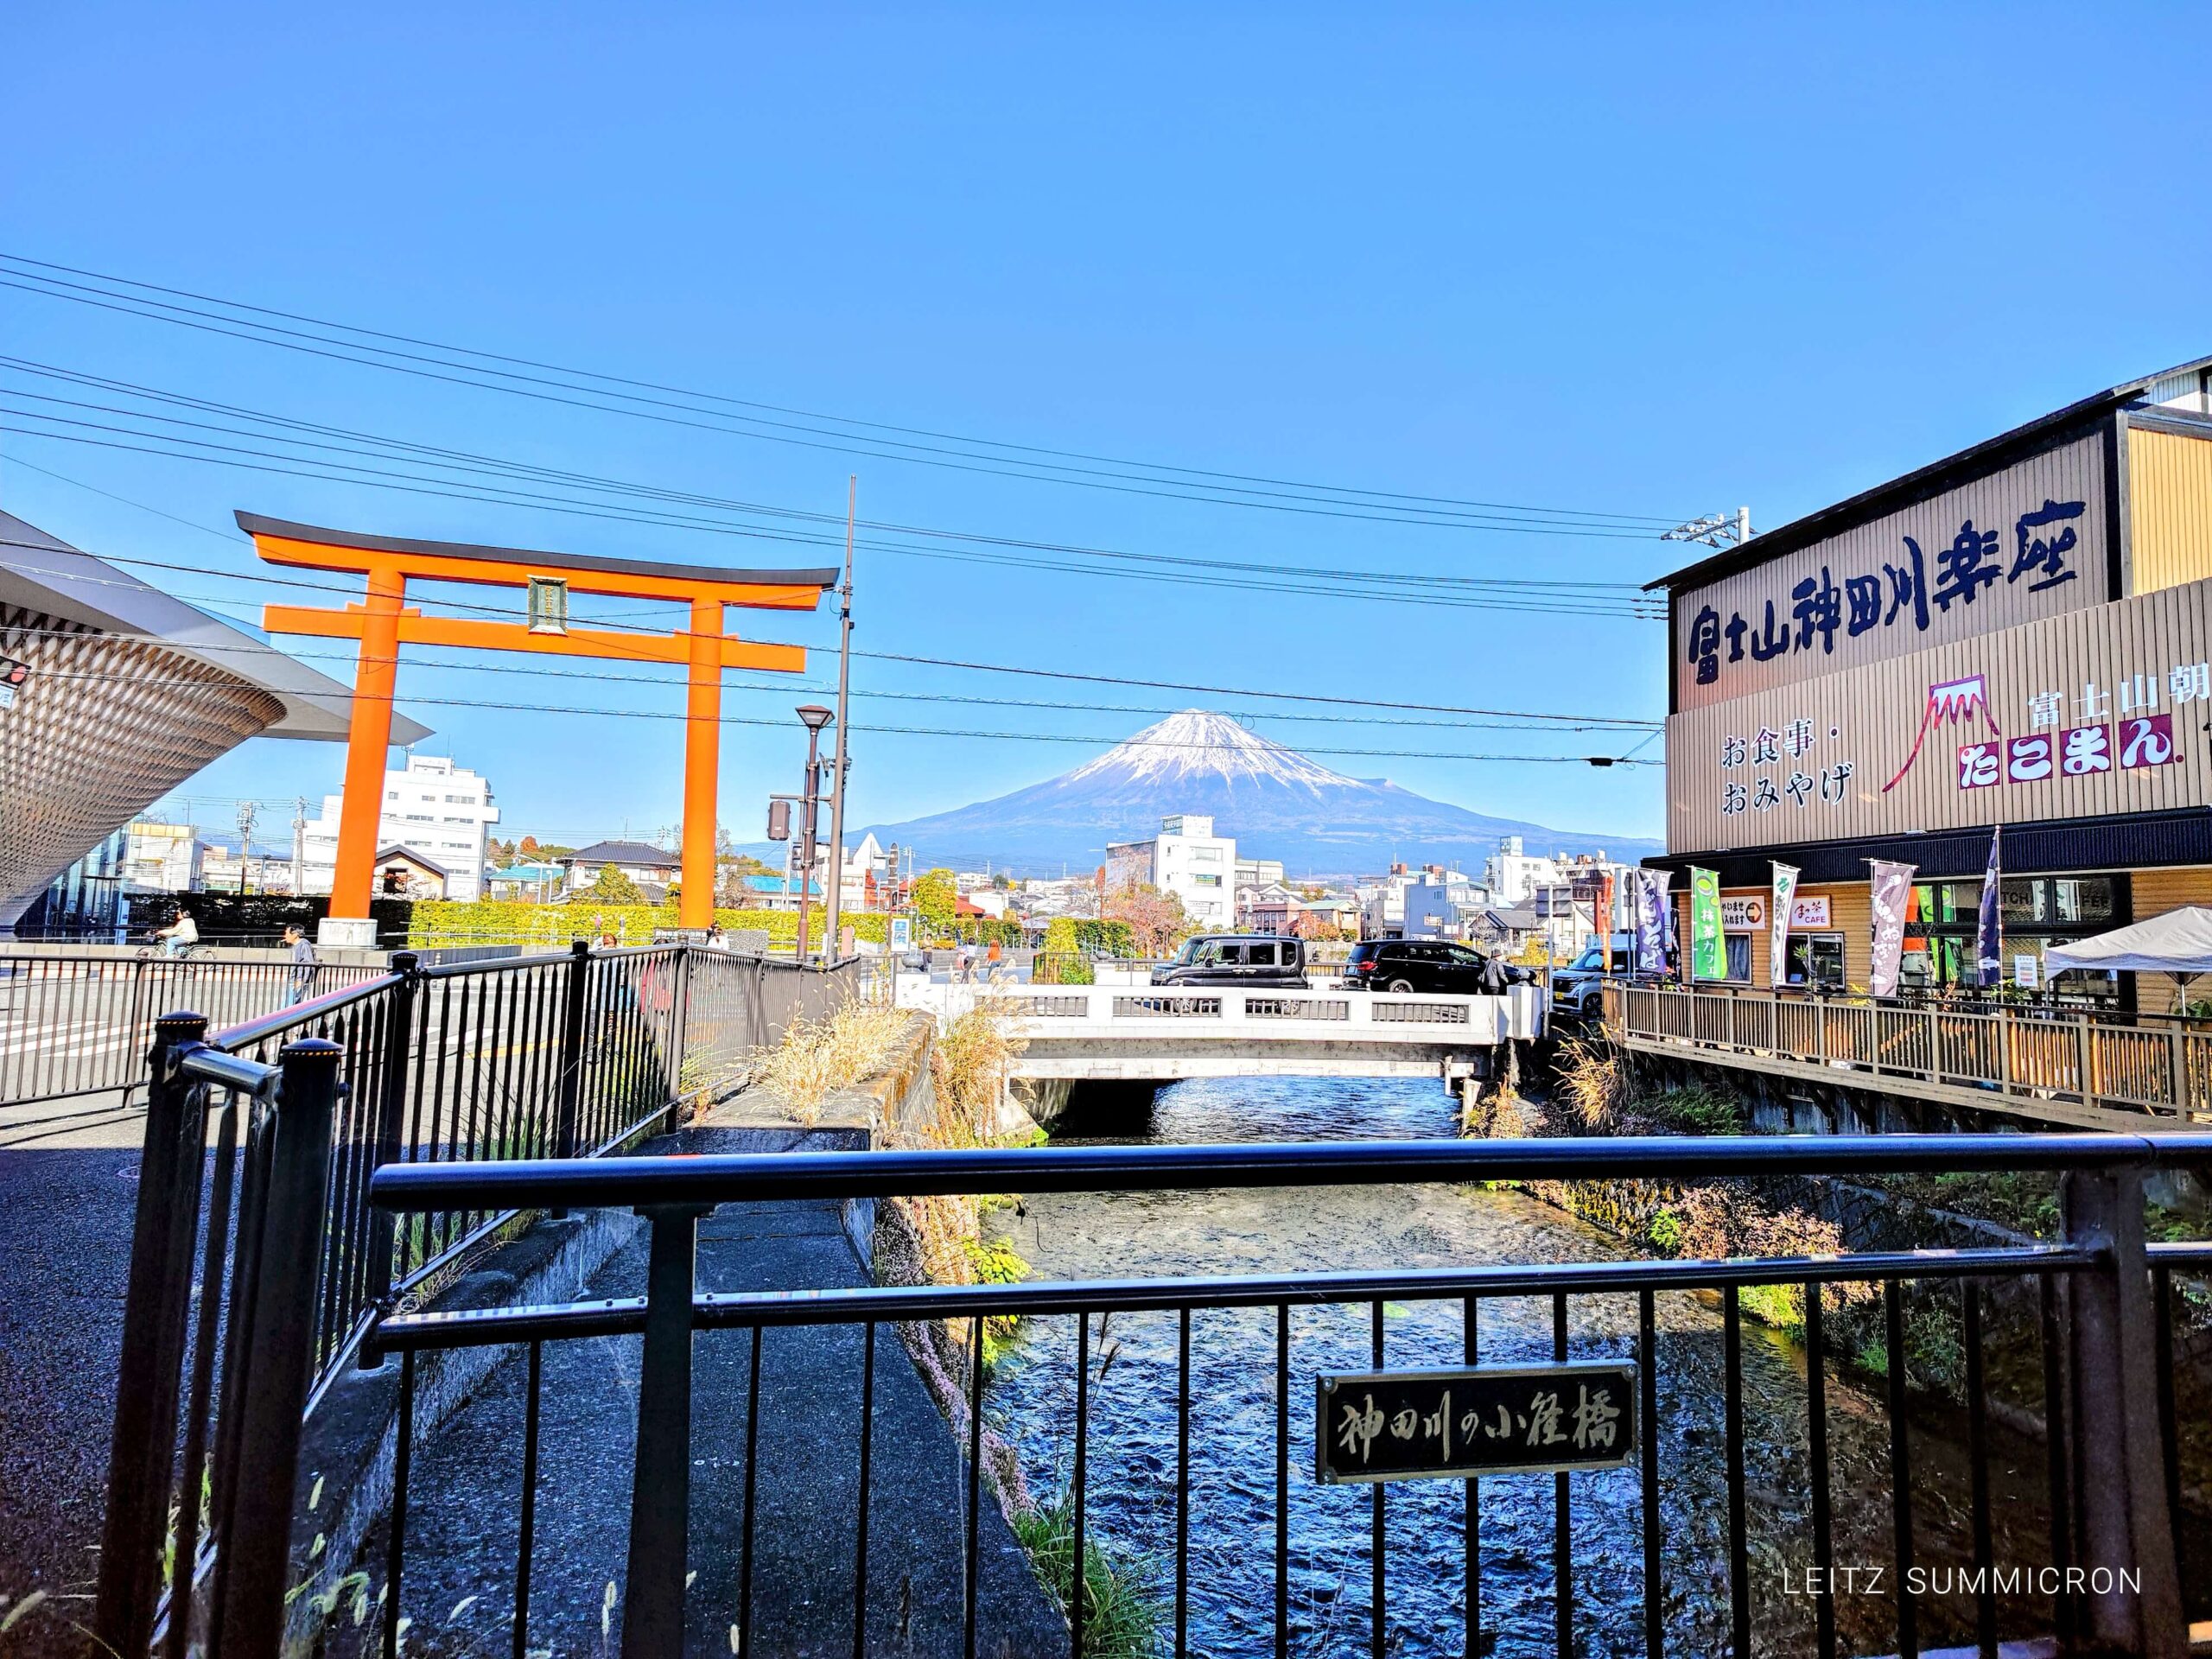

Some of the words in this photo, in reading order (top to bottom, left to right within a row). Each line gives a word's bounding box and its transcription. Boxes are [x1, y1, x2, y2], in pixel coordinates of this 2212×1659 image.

[1722, 763, 1853, 816] おみやげ
[1721, 914, 1745, 925] 入れます
